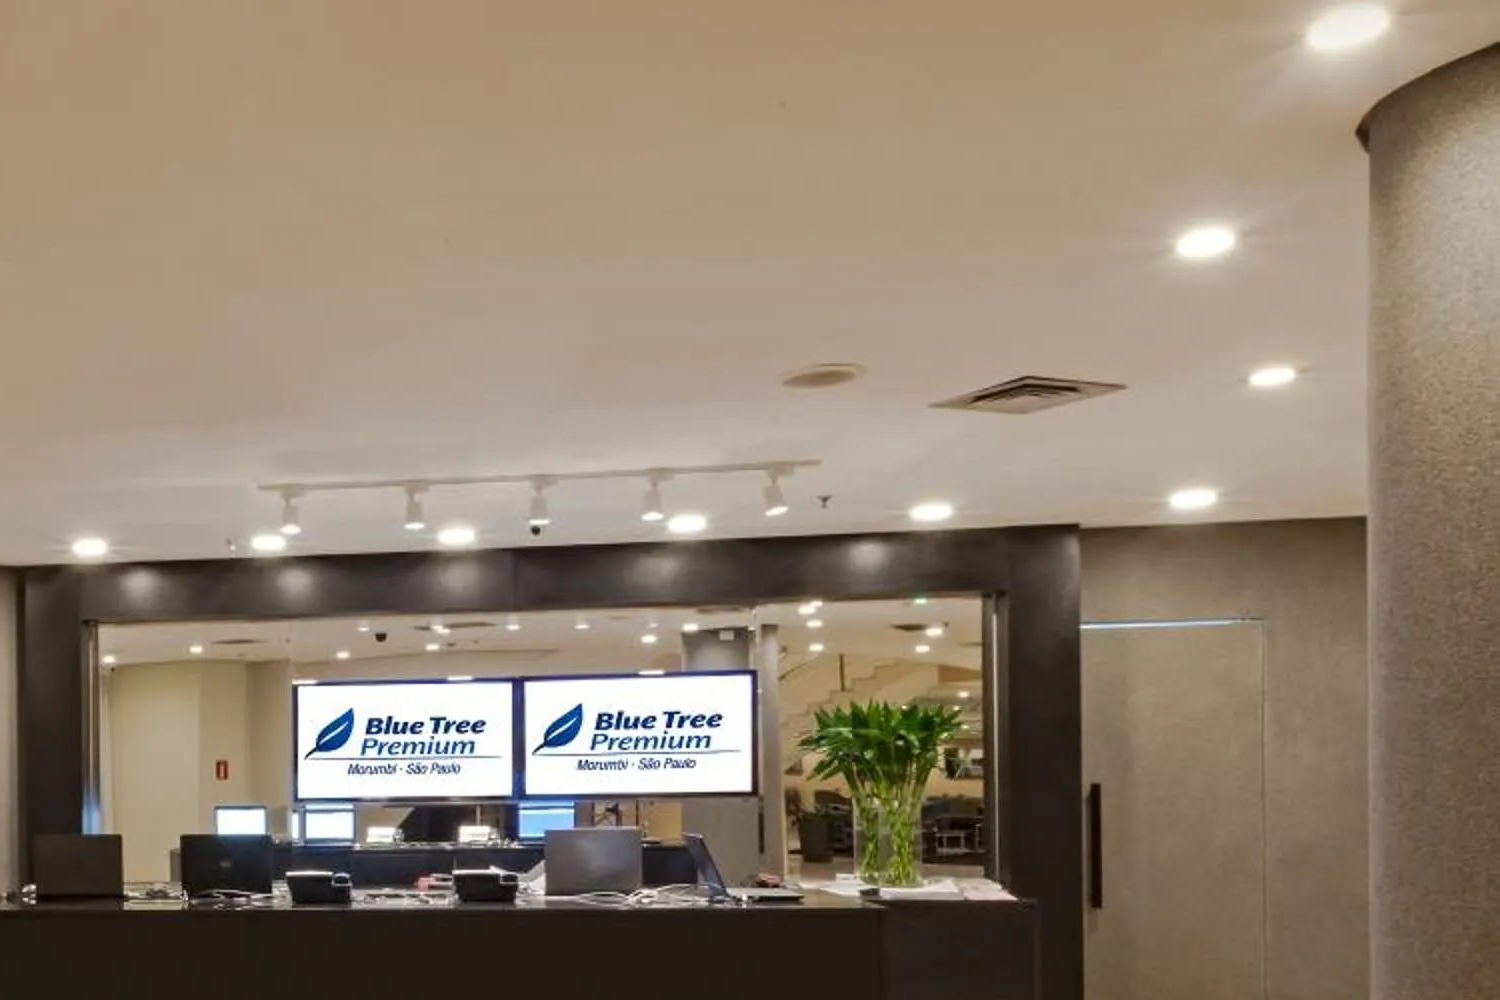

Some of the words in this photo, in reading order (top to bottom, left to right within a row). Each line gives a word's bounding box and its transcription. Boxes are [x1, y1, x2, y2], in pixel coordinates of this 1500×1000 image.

[365, 715, 425, 735] Blue
[429, 716, 487, 735] Tree
[594, 710, 657, 730] Blue
[662, 711, 723, 729] Tree
[360, 735, 476, 756] Premium
[590, 730, 712, 751] Premium
[348, 763, 398, 775] Morumbi
[405, 762, 428, 775] São
[429, 762, 461, 775] Paulo
[577, 758, 628, 771] Morumbi
[638, 757, 661, 770] São
[663, 757, 696, 770] Paulo
